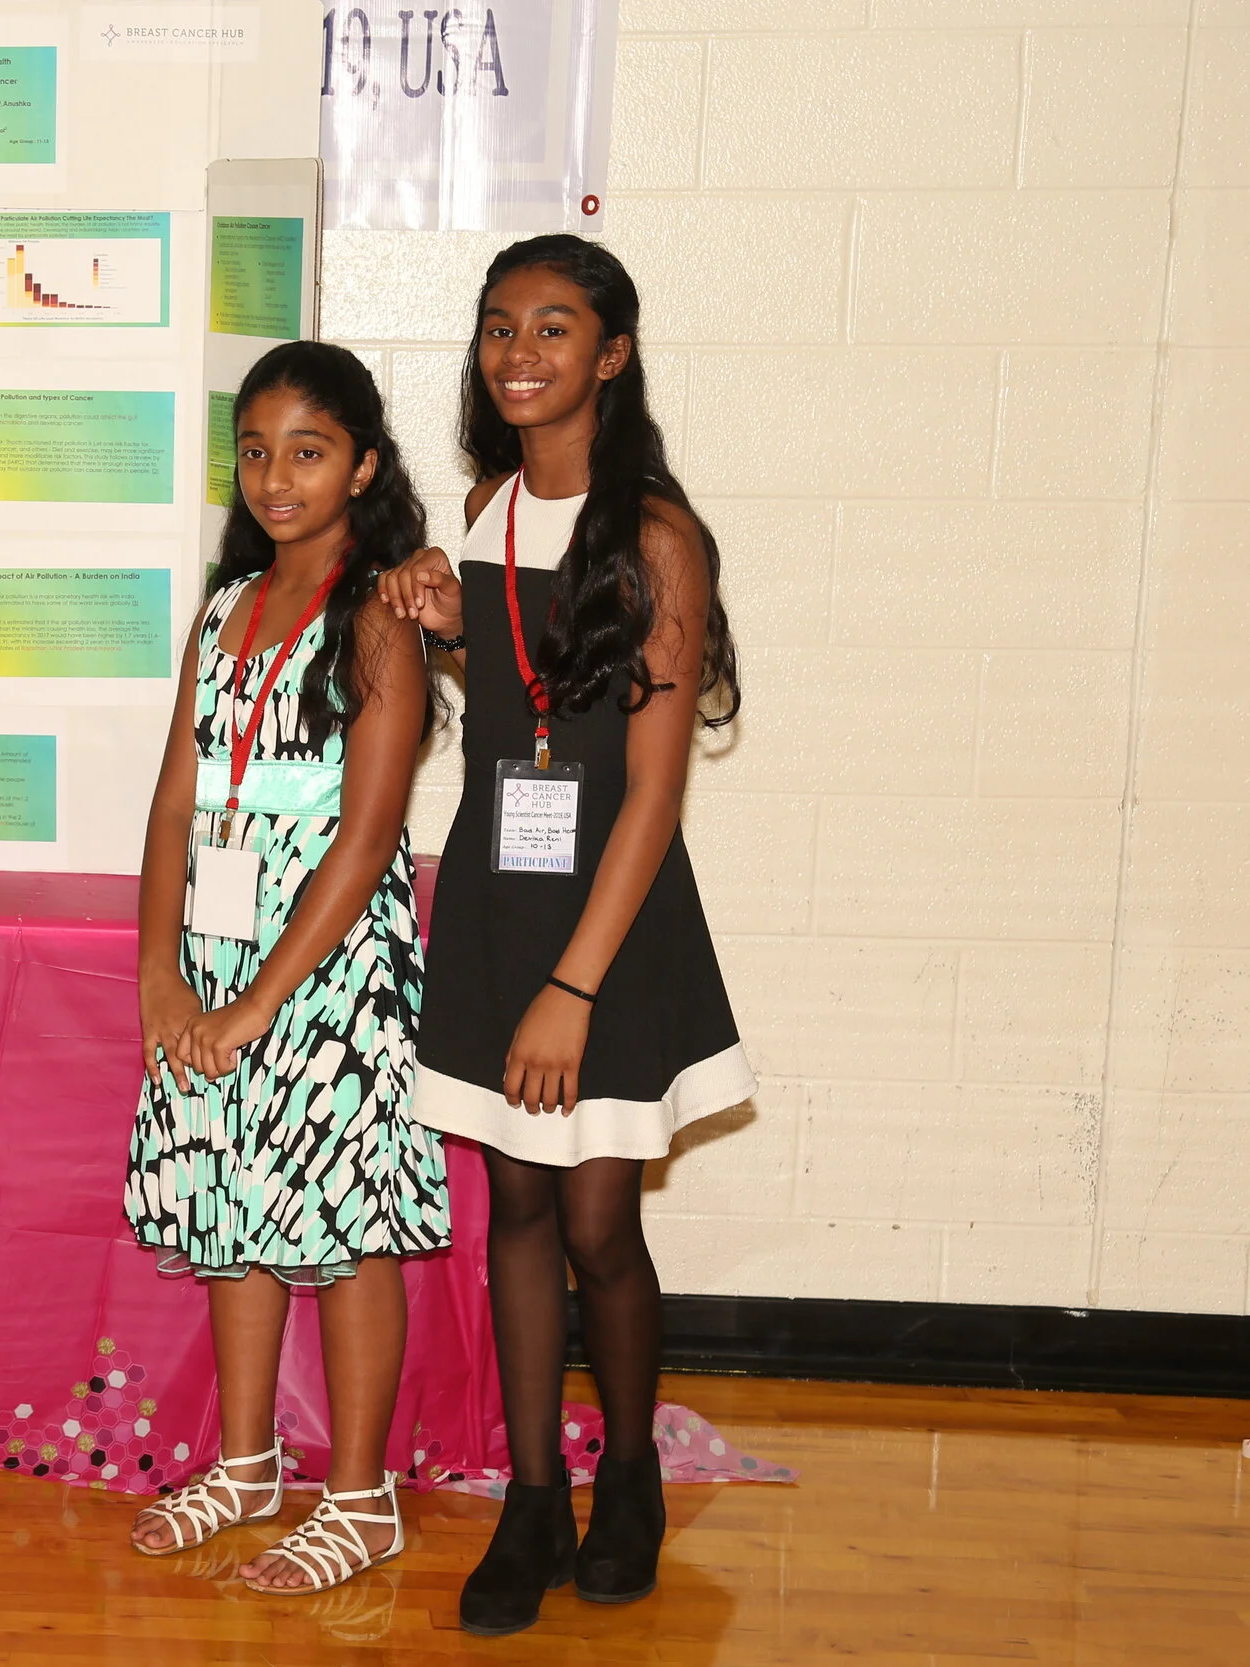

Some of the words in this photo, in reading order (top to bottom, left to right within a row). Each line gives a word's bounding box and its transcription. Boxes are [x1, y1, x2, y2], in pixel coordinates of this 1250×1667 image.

[126, 28, 168, 36] BREAST
[172, 28, 217, 38] CANCER
[222, 29, 244, 38] HUB
[398, 8, 509, 98] USA
[533, 784, 568, 792] BREAST
[504, 856, 567, 868] PARTICIPANT
